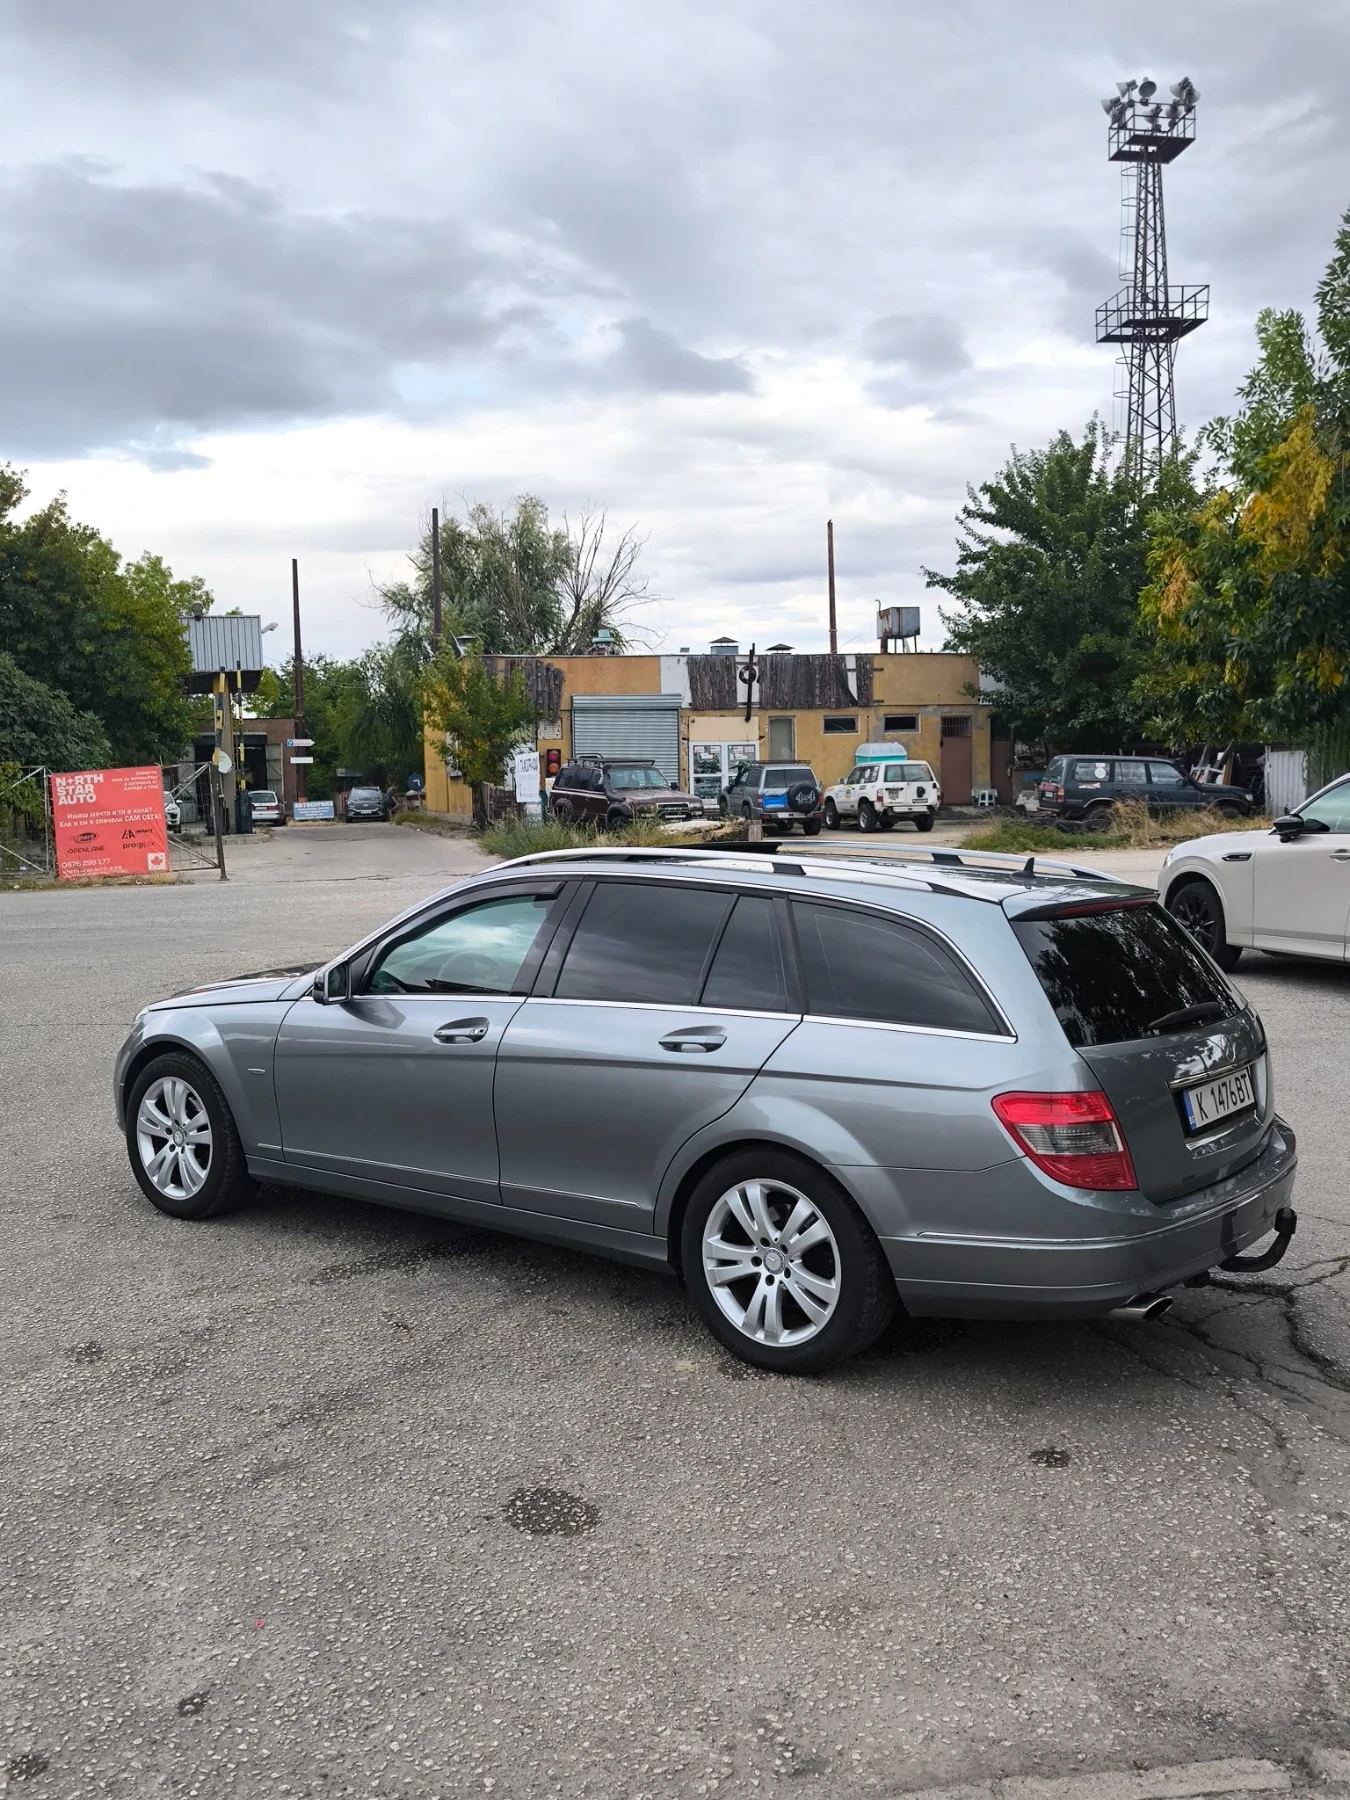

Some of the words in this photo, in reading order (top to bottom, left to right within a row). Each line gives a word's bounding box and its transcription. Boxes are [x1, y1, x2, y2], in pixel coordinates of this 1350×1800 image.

[57, 784, 95, 796] STAR
[58, 793, 97, 806] AUTO
[67, 812, 89, 820] Имаш
[90, 811, 111, 819] мечта
[133, 806, 153, 814] кола?
[95, 817, 124, 825] спечели
[141, 813, 162, 821] СЕГА!
[68, 846, 105, 854] OPENLANE
[1195, 1091, 1209, 1121] K
